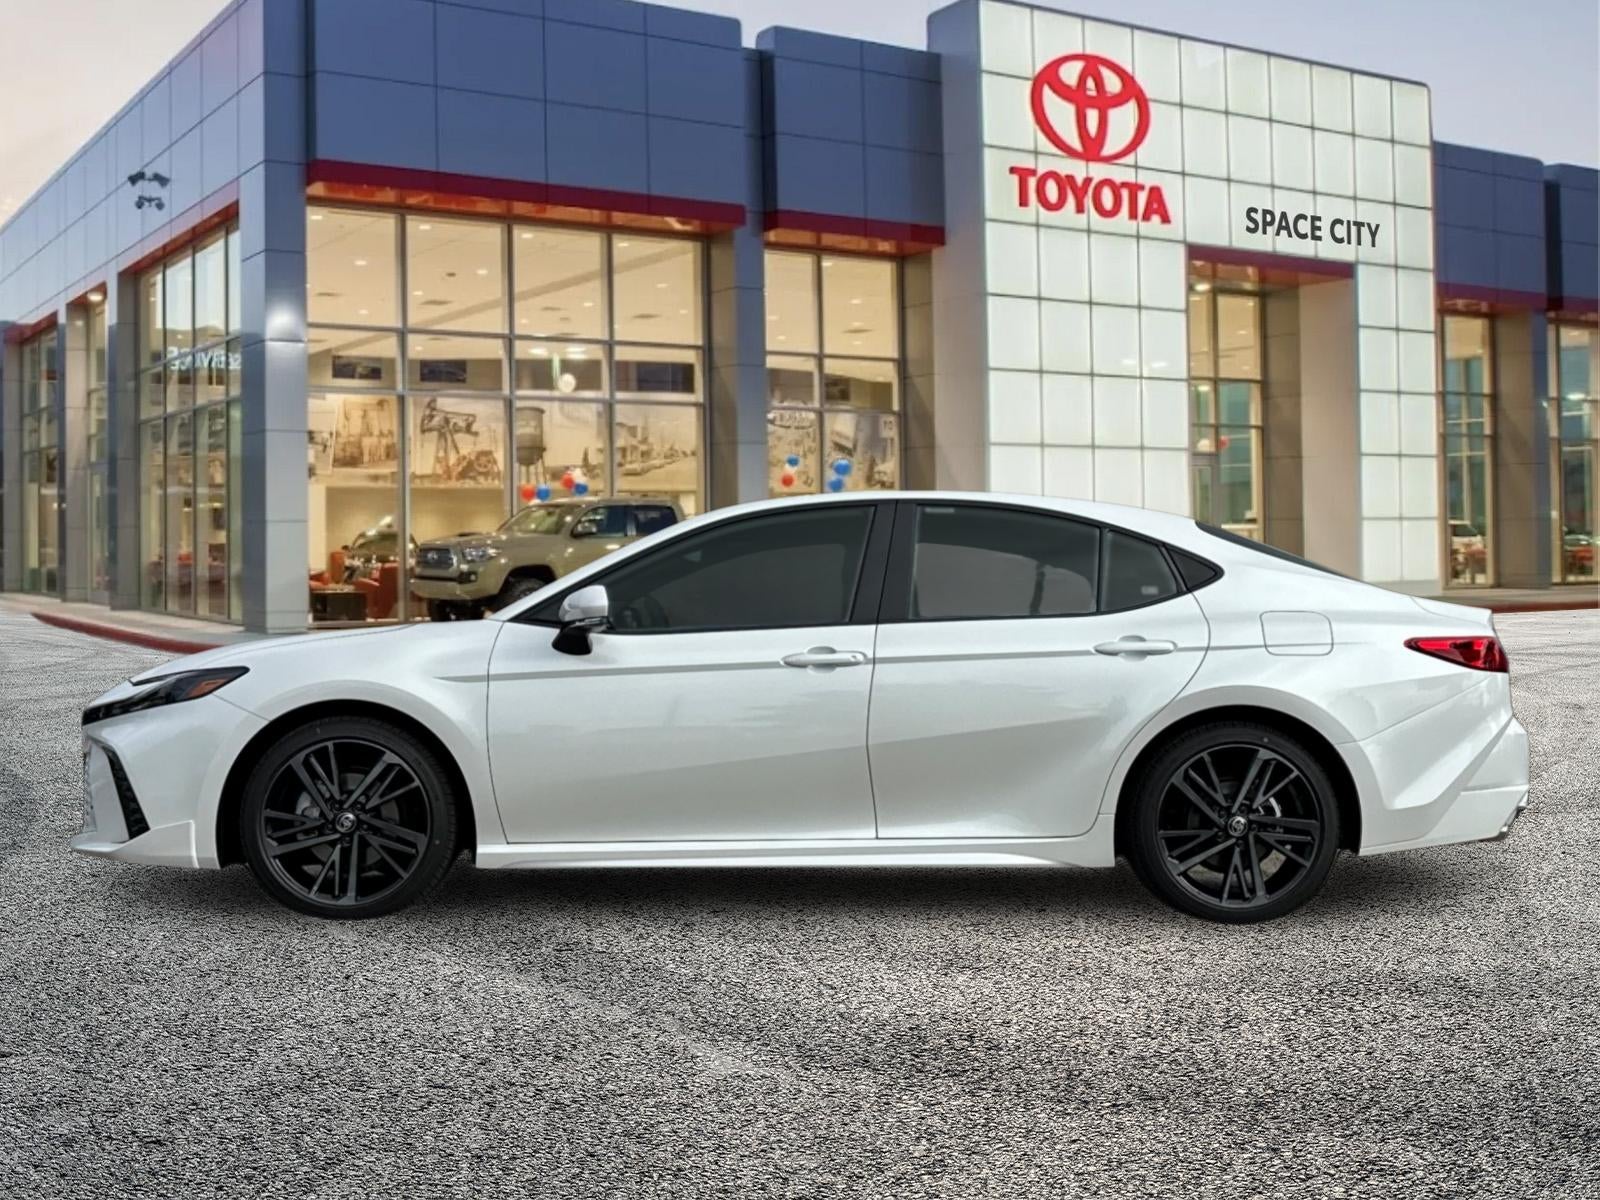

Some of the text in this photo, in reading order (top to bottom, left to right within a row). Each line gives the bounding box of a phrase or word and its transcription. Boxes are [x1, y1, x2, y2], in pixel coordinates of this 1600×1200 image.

[1009, 166, 1171, 224] TOYOTA
[1245, 206, 1380, 248] SPACE CITY
